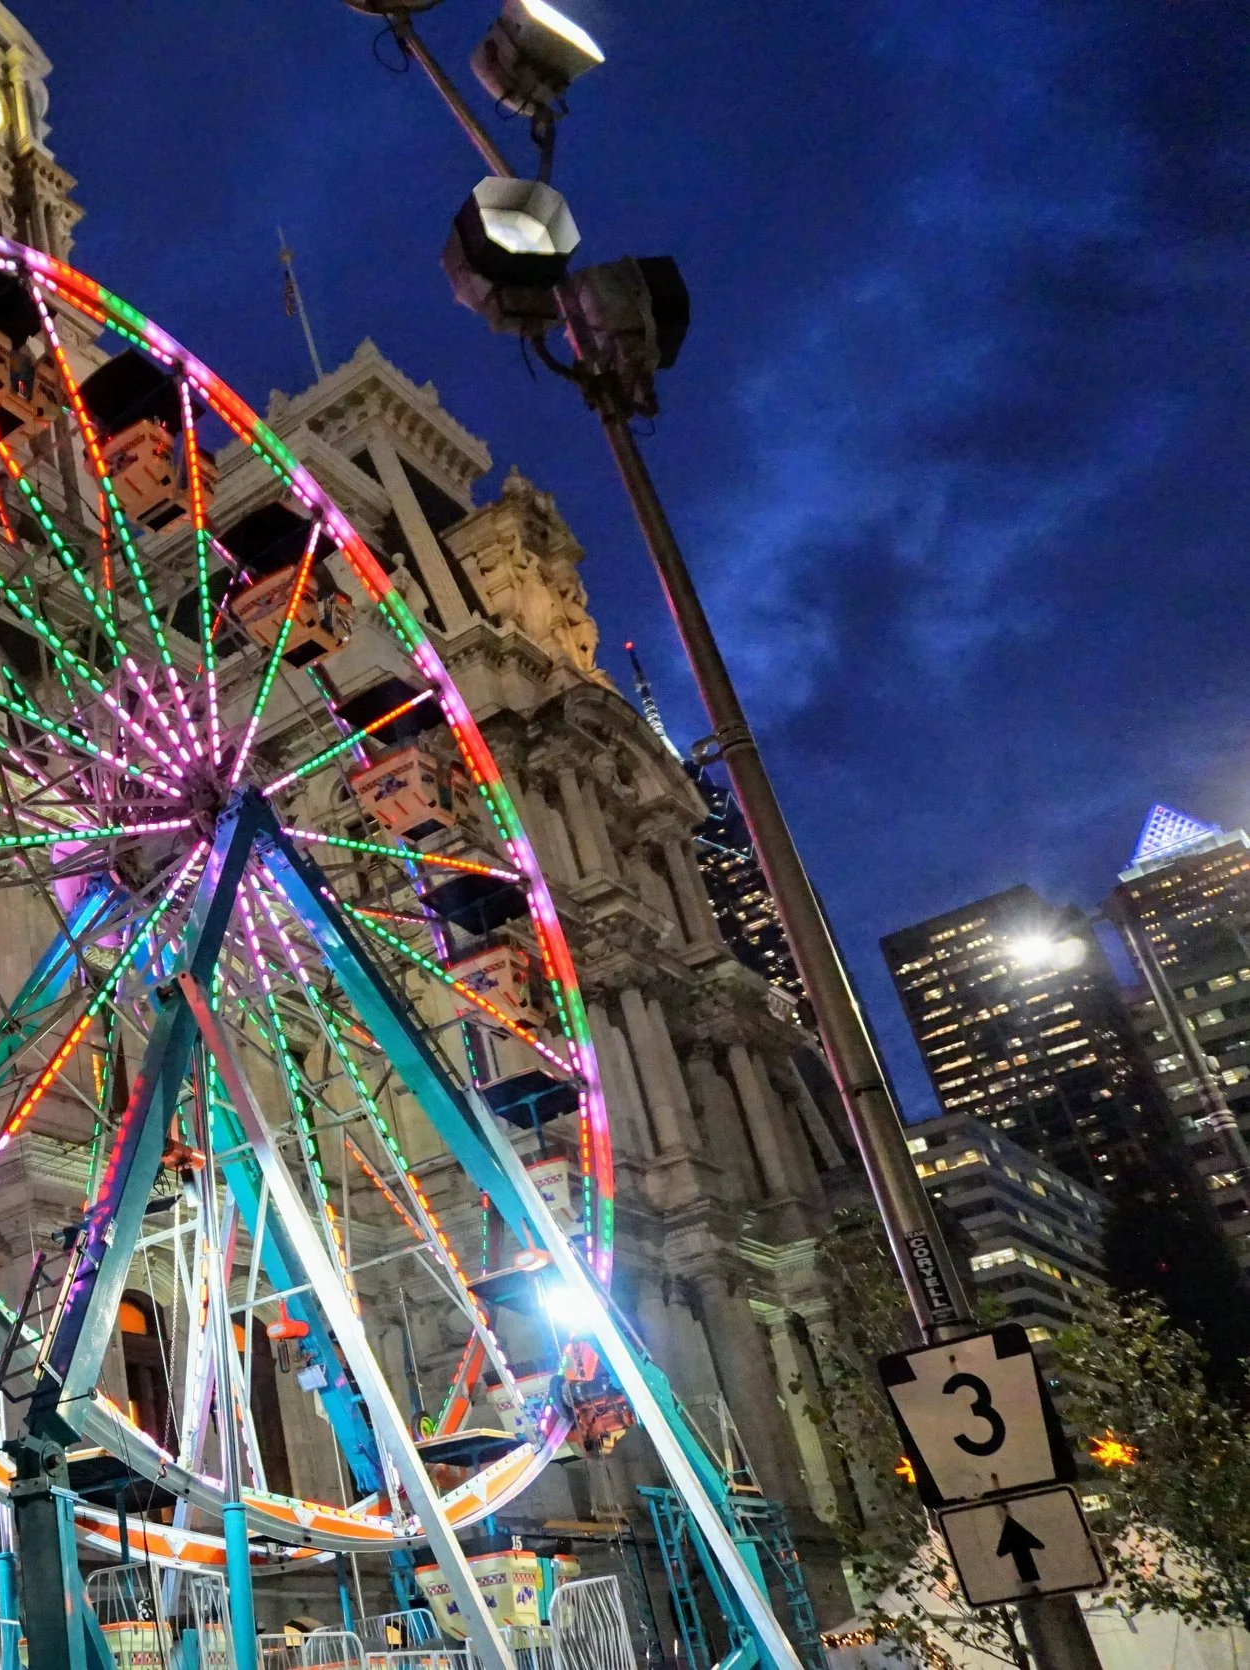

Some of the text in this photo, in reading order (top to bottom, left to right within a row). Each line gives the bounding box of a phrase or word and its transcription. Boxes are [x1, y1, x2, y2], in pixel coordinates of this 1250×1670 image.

[909, 1238, 948, 1308] CORYELL
[942, 1372, 1006, 1457] 3
[511, 1534, 523, 1551] 15
